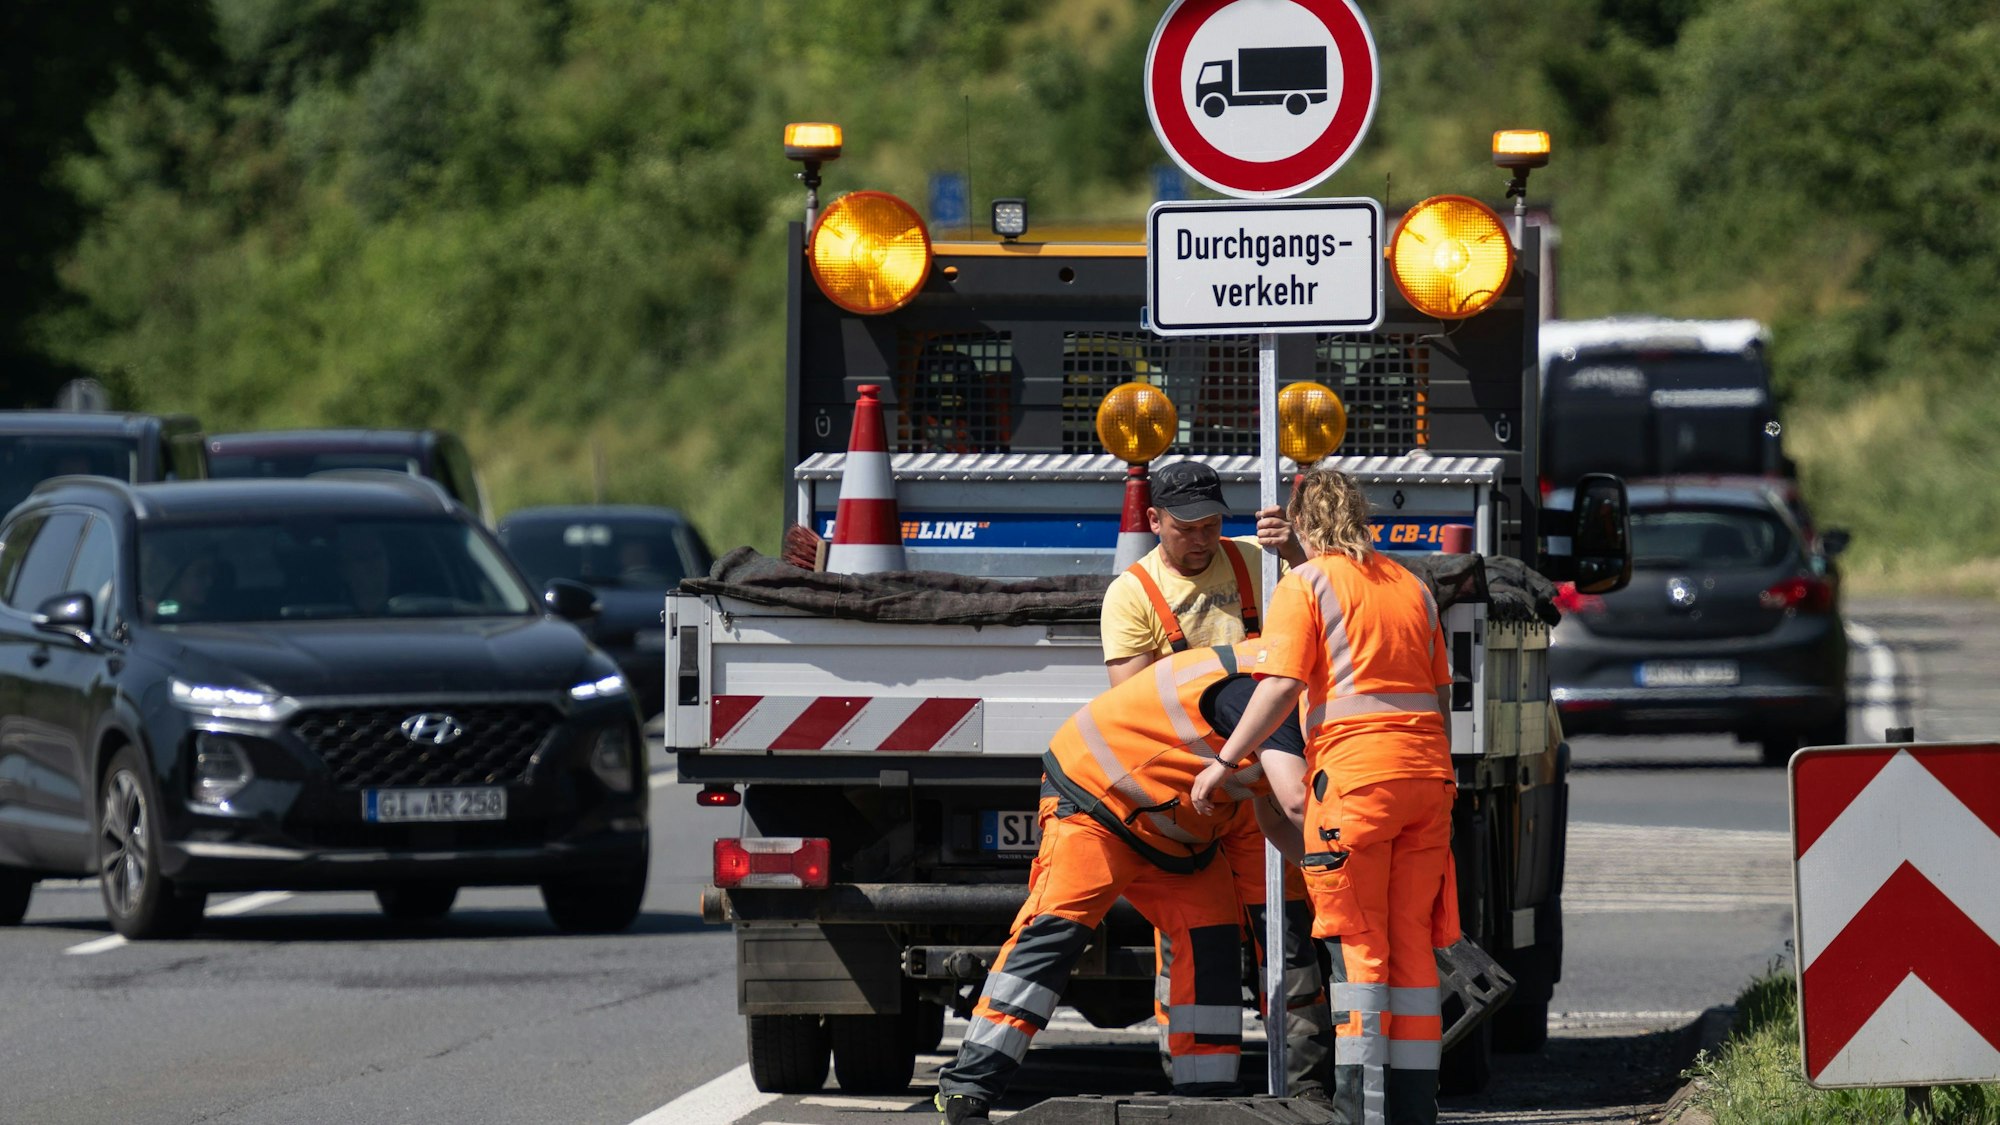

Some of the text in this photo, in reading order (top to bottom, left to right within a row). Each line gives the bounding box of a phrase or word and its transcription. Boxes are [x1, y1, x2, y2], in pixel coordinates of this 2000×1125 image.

[1177, 227, 1353, 267] Durchgangs-
[1212, 274, 1319, 307] verkehr
[985, 834, 993, 844] D
[1003, 815, 1036, 845] SI
